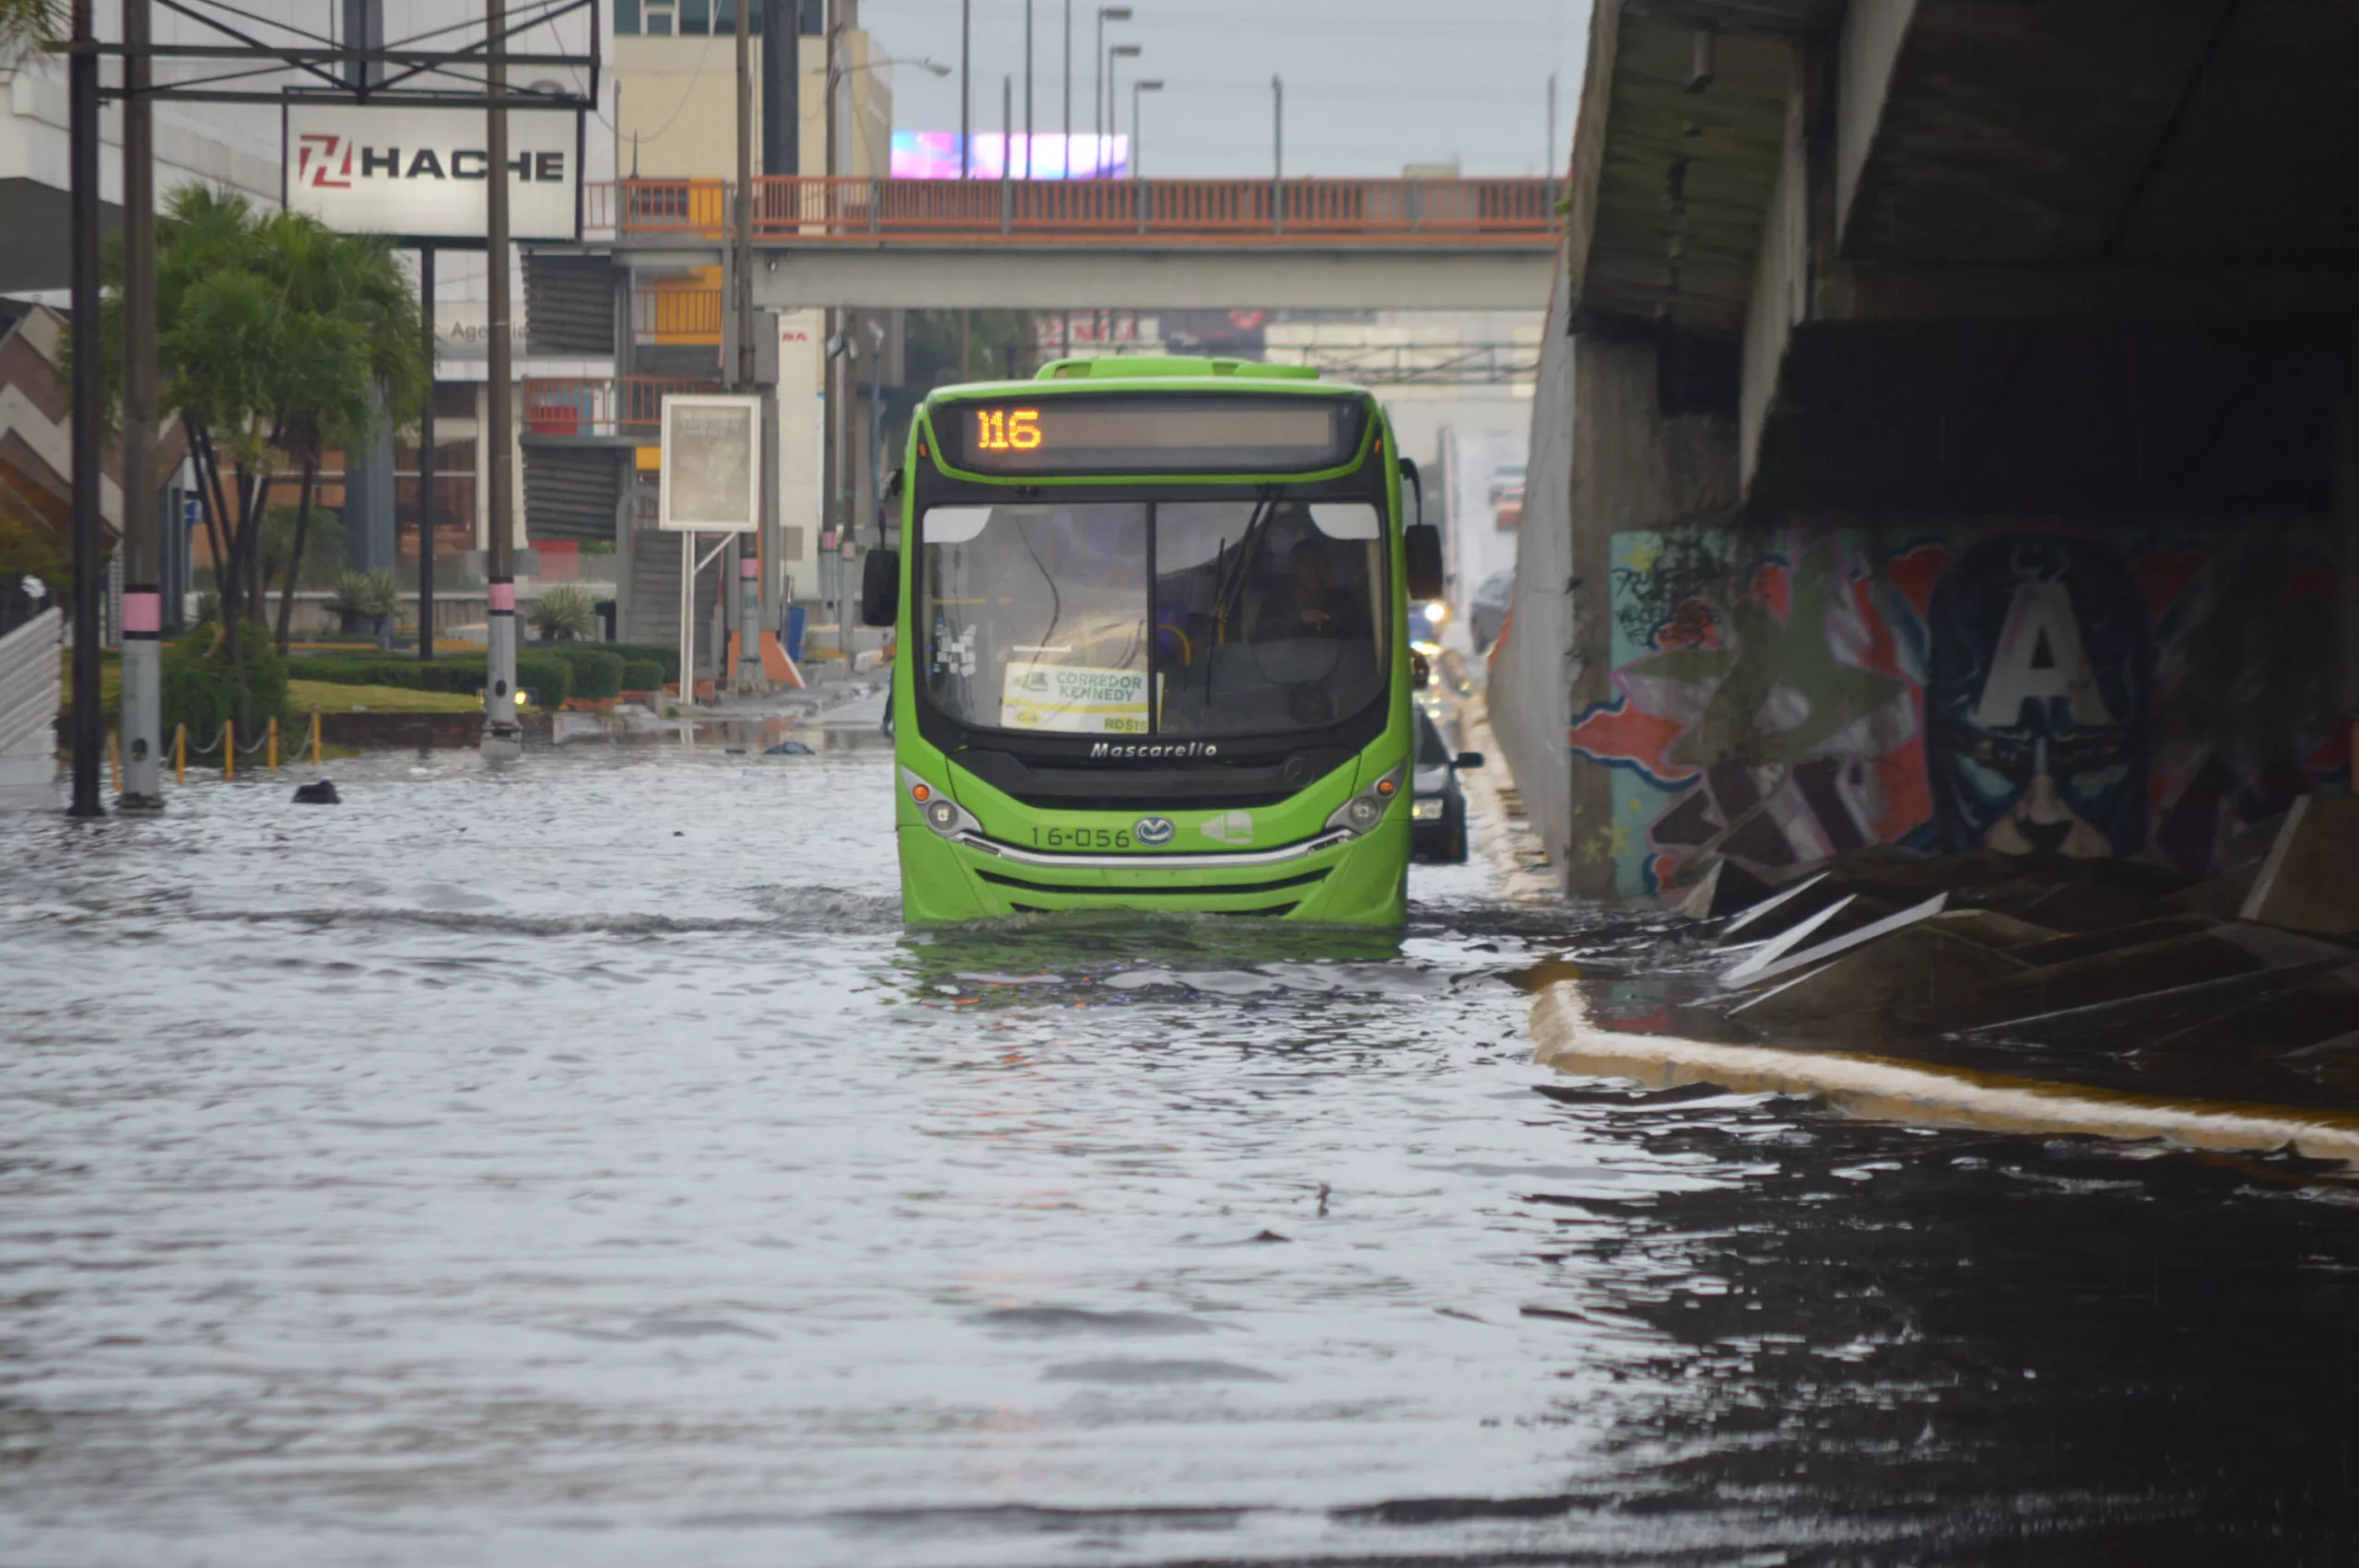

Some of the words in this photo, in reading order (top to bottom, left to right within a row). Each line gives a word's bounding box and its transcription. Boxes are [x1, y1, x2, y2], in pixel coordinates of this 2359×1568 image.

[361, 146, 564, 182] HACHE
[451, 322, 527, 343] Ageia
[1056, 672, 1143, 689] CORREDOR
[1060, 686, 1134, 702] KENNEDY
[1090, 742, 1217, 758] Mascarello
[1031, 827, 1130, 848] 16-056
